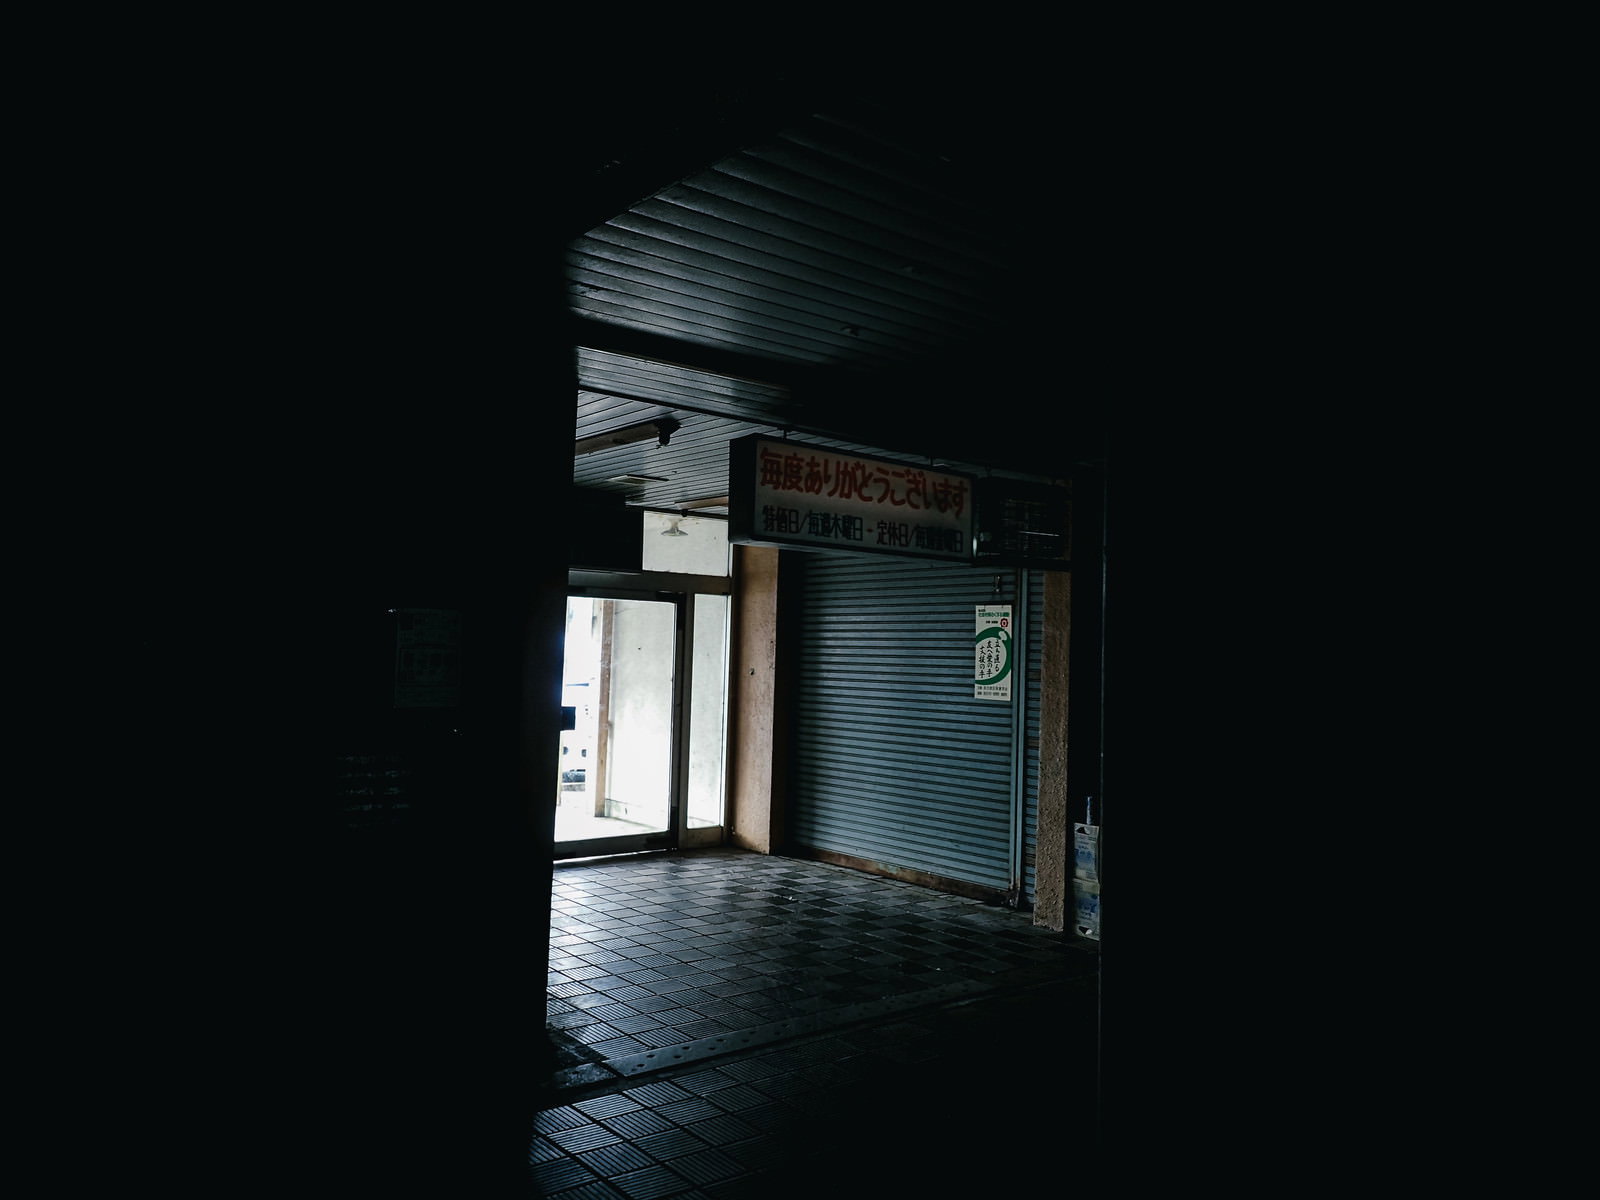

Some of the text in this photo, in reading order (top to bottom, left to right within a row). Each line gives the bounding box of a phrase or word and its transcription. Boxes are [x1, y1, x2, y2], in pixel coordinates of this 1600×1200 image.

[760, 447, 968, 519] 毎度ありがとうございます
